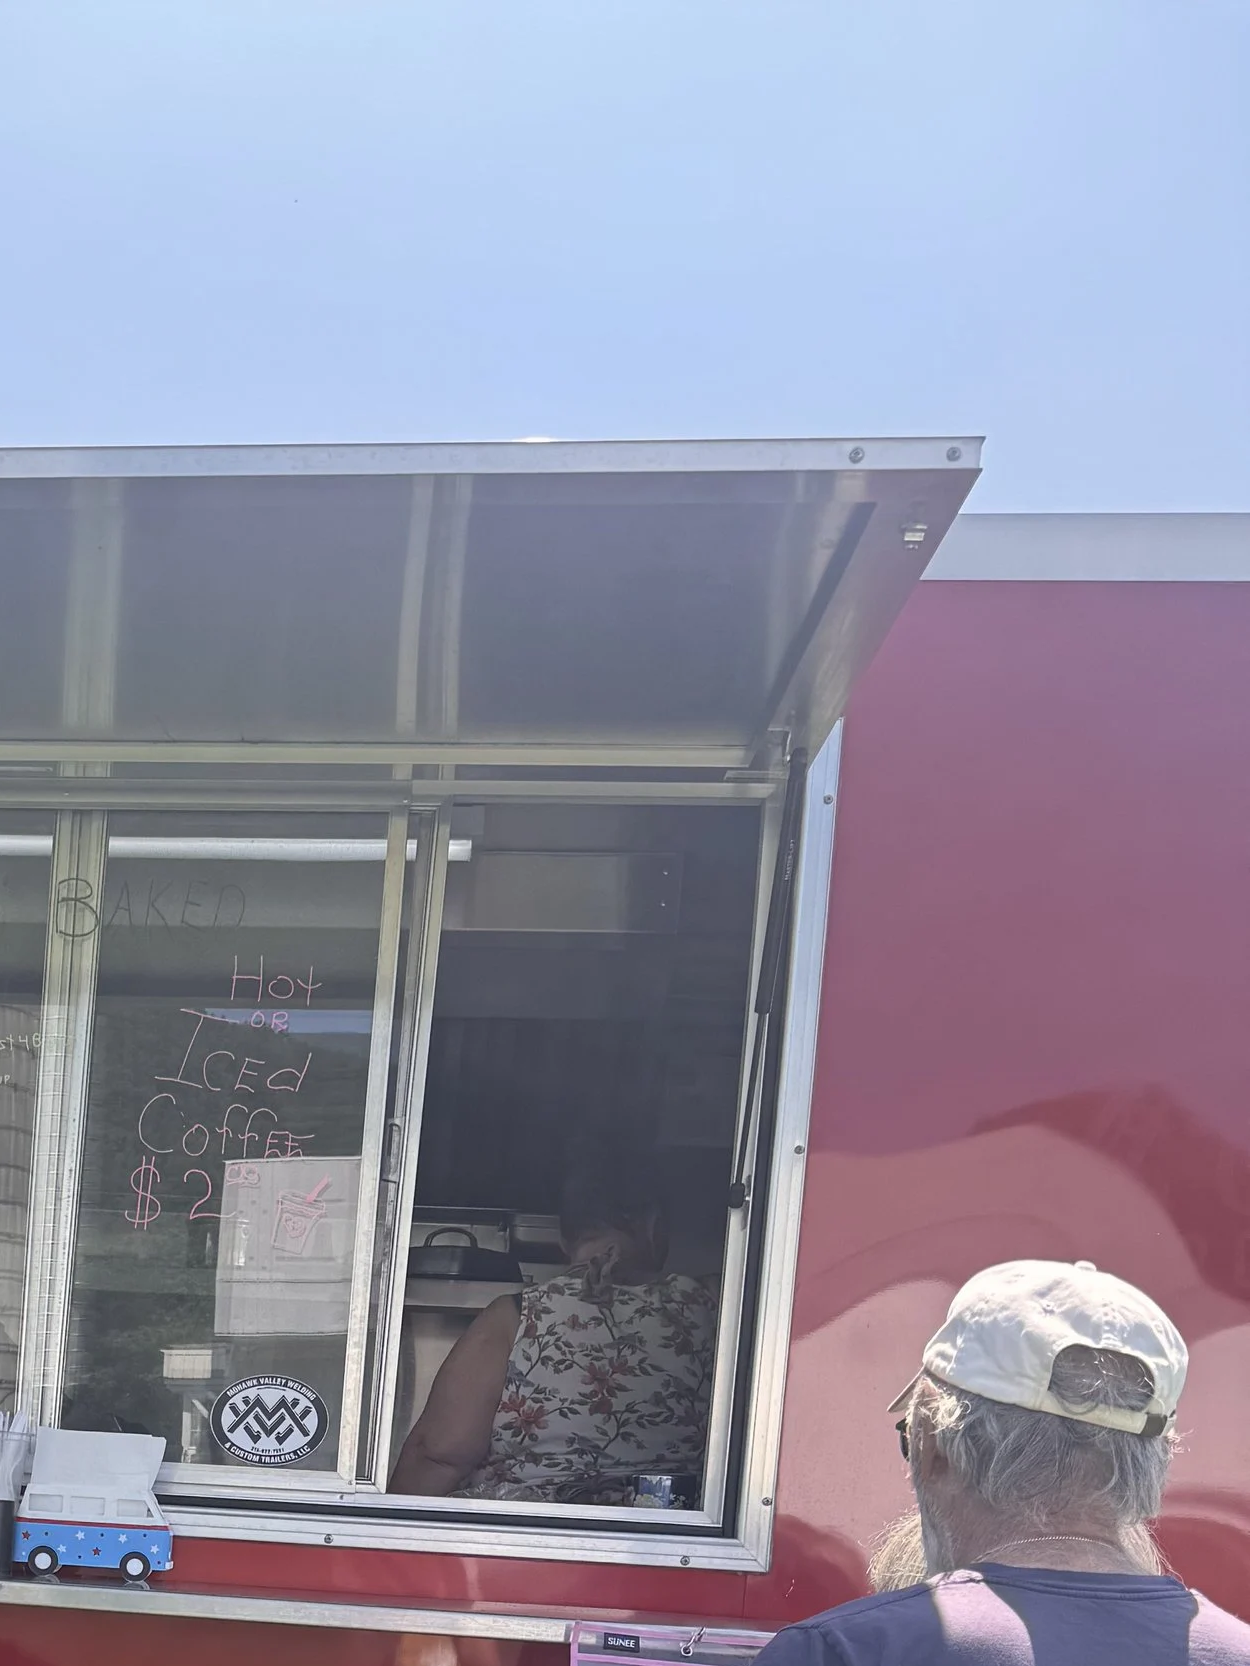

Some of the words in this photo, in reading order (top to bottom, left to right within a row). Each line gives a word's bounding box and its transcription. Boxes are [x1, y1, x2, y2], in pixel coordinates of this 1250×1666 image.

[250, 1010, 290, 1033] OR
[226, 1377, 259, 1398] MOHAWK
[259, 1377, 287, 1386] VALLEY
[287, 1379, 317, 1401] WELDING
[230, 1443, 260, 1463] CUSTOM
[297, 1445, 312, 1457] LLC
[607, 1636, 636, 1649] SUNEE
